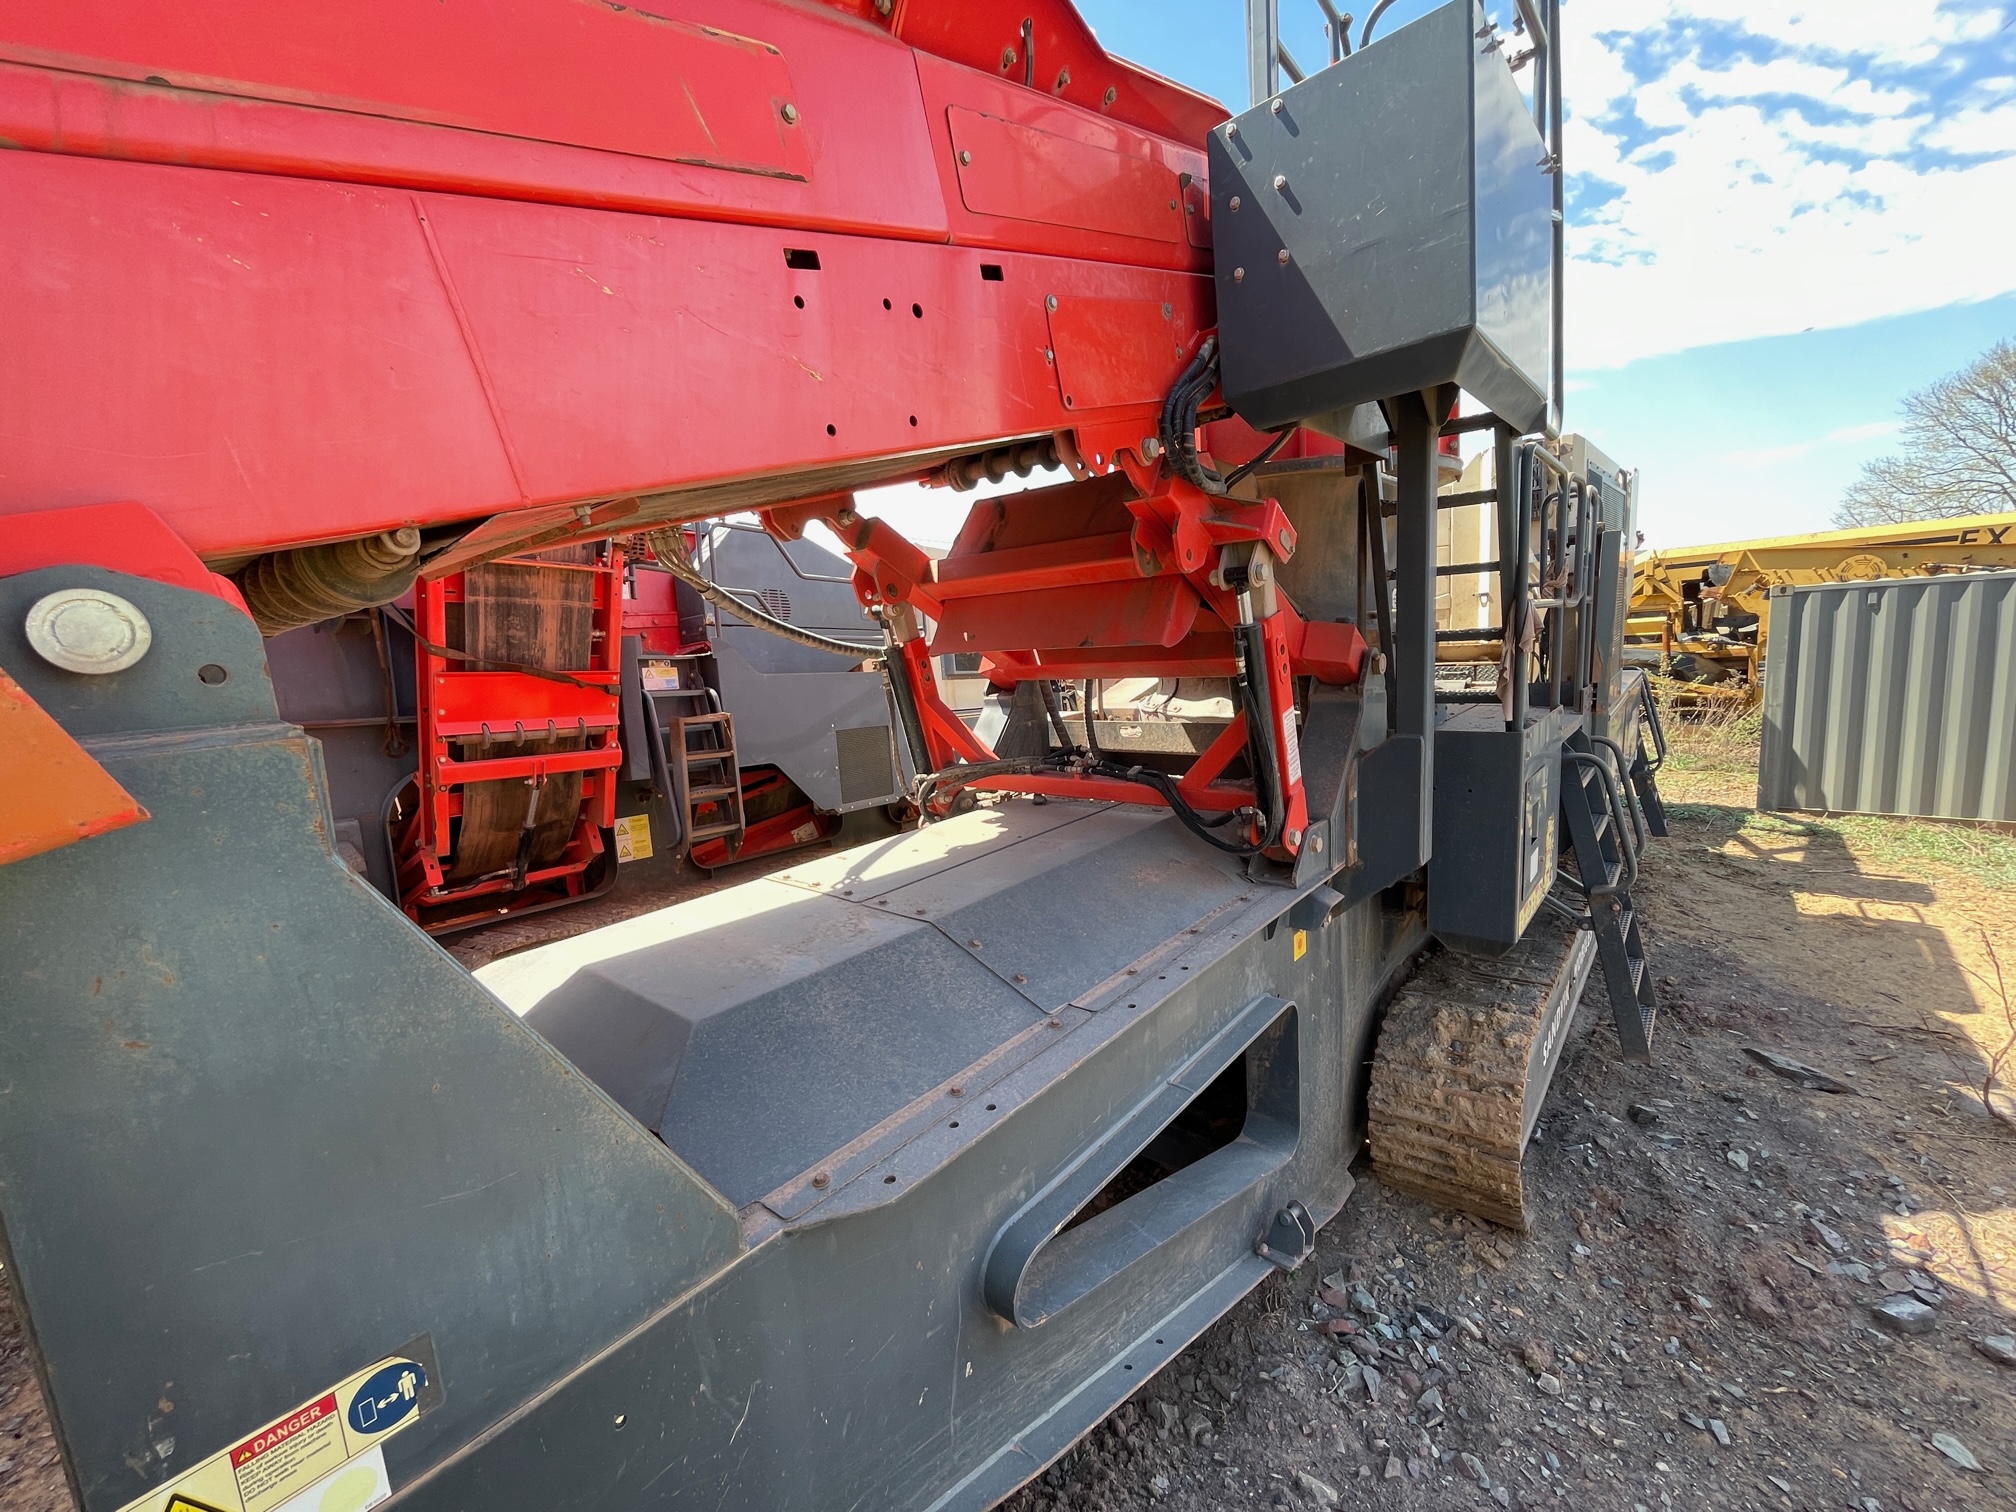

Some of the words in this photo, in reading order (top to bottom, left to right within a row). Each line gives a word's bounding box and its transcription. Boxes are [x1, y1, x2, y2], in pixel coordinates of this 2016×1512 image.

[238, 1452, 268, 1474] FALLING
[270, 1430, 305, 1454] MATERIAL
[306, 1412, 335, 1432] HAZARD
[240, 1467, 254, 1479] Risk
[264, 1448, 287, 1465] serious
[289, 1437, 306, 1450] injury
[315, 1420, 333, 1434] death
[253, 1406, 321, 1453] DANGER
[241, 1470, 261, 1485] KEEP
[261, 1457, 282, 1473] AWAY
[284, 1447, 299, 1459] from
[300, 1431, 326, 1449] machine
[242, 1475, 263, 1491] during
[264, 1456, 295, 1477] operation
[256, 1476, 273, 1489] NOT
[274, 1466, 288, 1478] walk
[290, 1457, 304, 1468] near
[305, 1441, 331, 1458] material
[244, 1480, 277, 1503] discharge
[278, 1468, 297, 1482] areas
